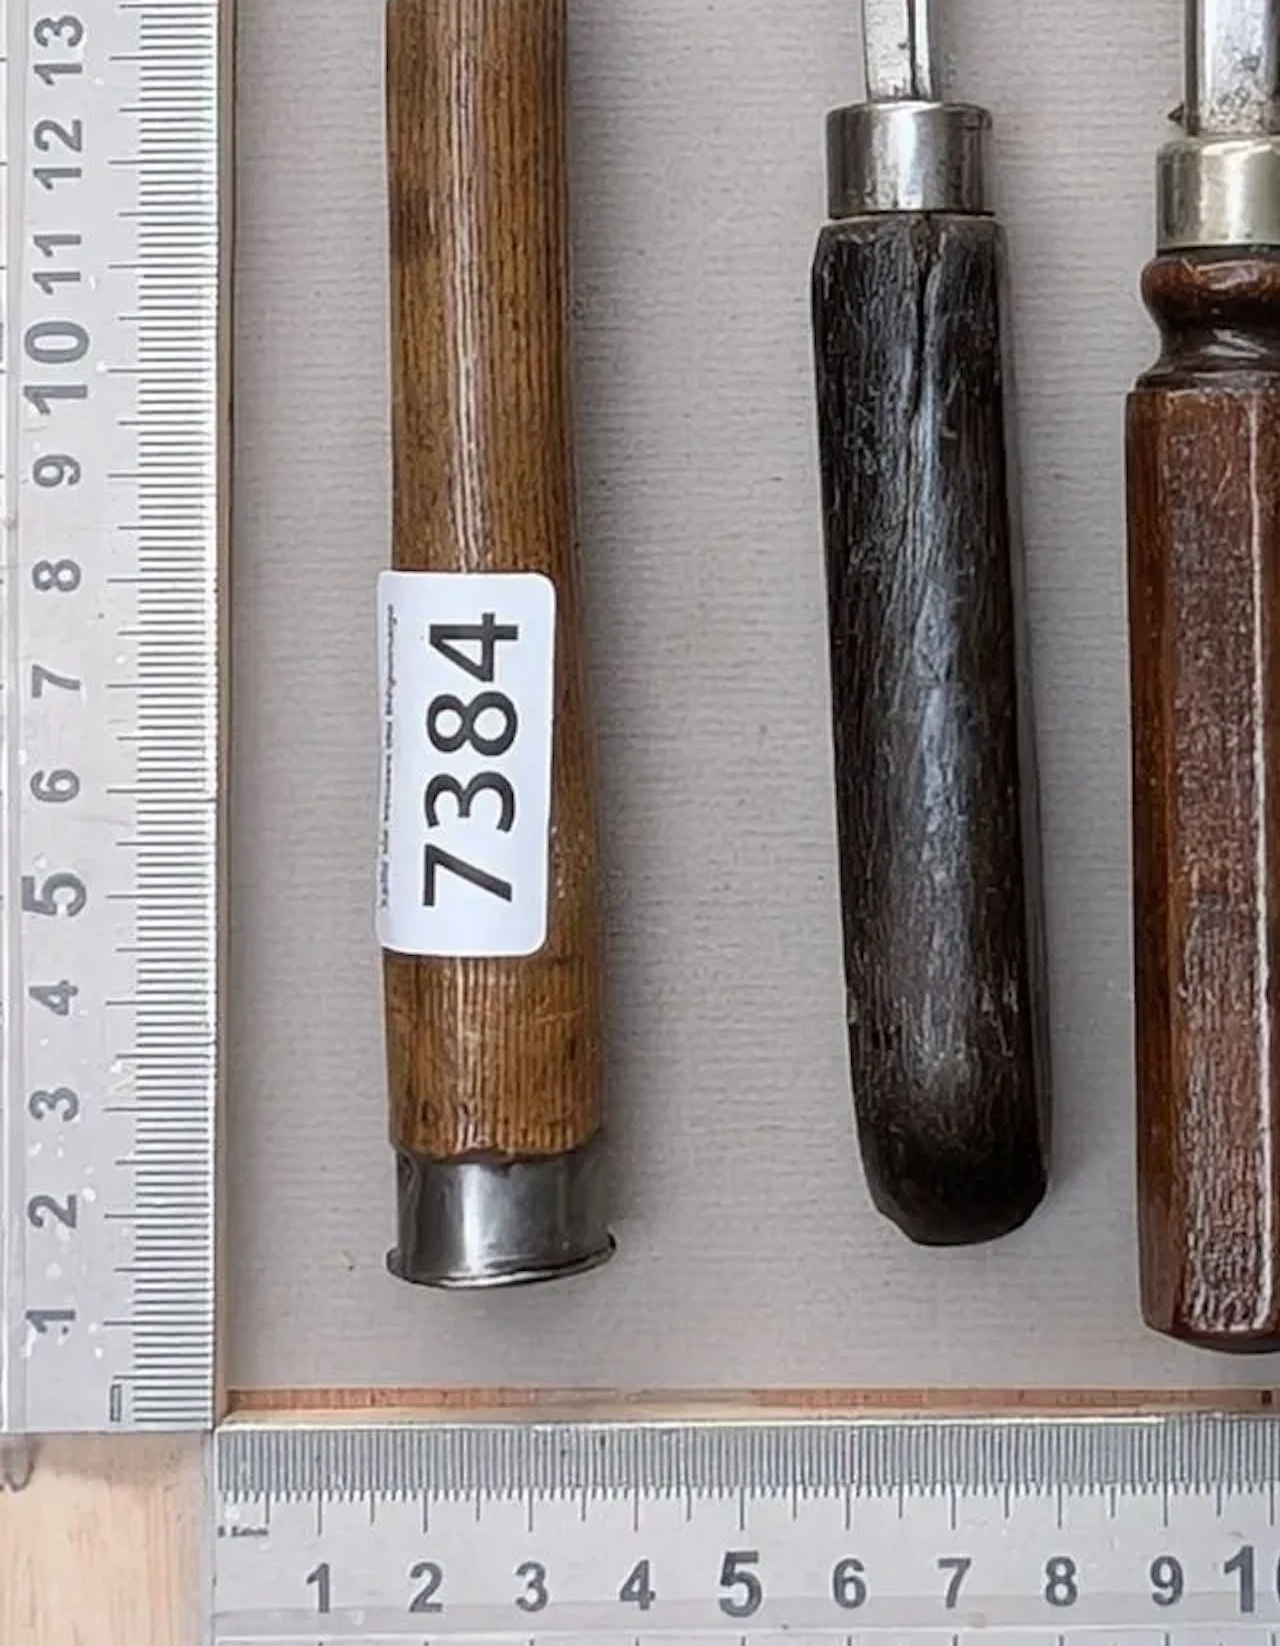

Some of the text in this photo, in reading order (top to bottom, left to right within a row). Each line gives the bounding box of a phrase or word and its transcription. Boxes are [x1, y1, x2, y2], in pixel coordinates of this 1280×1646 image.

[33, 15, 84, 86] 13
[33, 119, 82, 190] 12
[32, 234, 82, 295] 11
[23, 321, 90, 416] 10
[33, 455, 81, 488] 9
[32, 560, 81, 592] 8
[32, 665, 81, 698] 7
[422, 611, 519, 908] 7384
[30, 769, 80, 803] 6
[22, 873, 87, 917] 5
[29, 980, 79, 1016] 4
[28, 1088, 79, 1122] 3
[27, 1194, 77, 1229] 2
[25, 1309, 76, 1334] 1
[306, 1563, 330, 1614] 1
[408, 1562, 444, 1614] 2
[515, 1561, 548, 1613] 3
[619, 1559, 656, 1611] 4
[718, 1550, 762, 1618] 5
[832, 1558, 866, 1611] 6
[937, 1557, 972, 1610] 7
[1044, 1556, 1078, 1609] 8
[1150, 1555, 1184, 1608] 9
